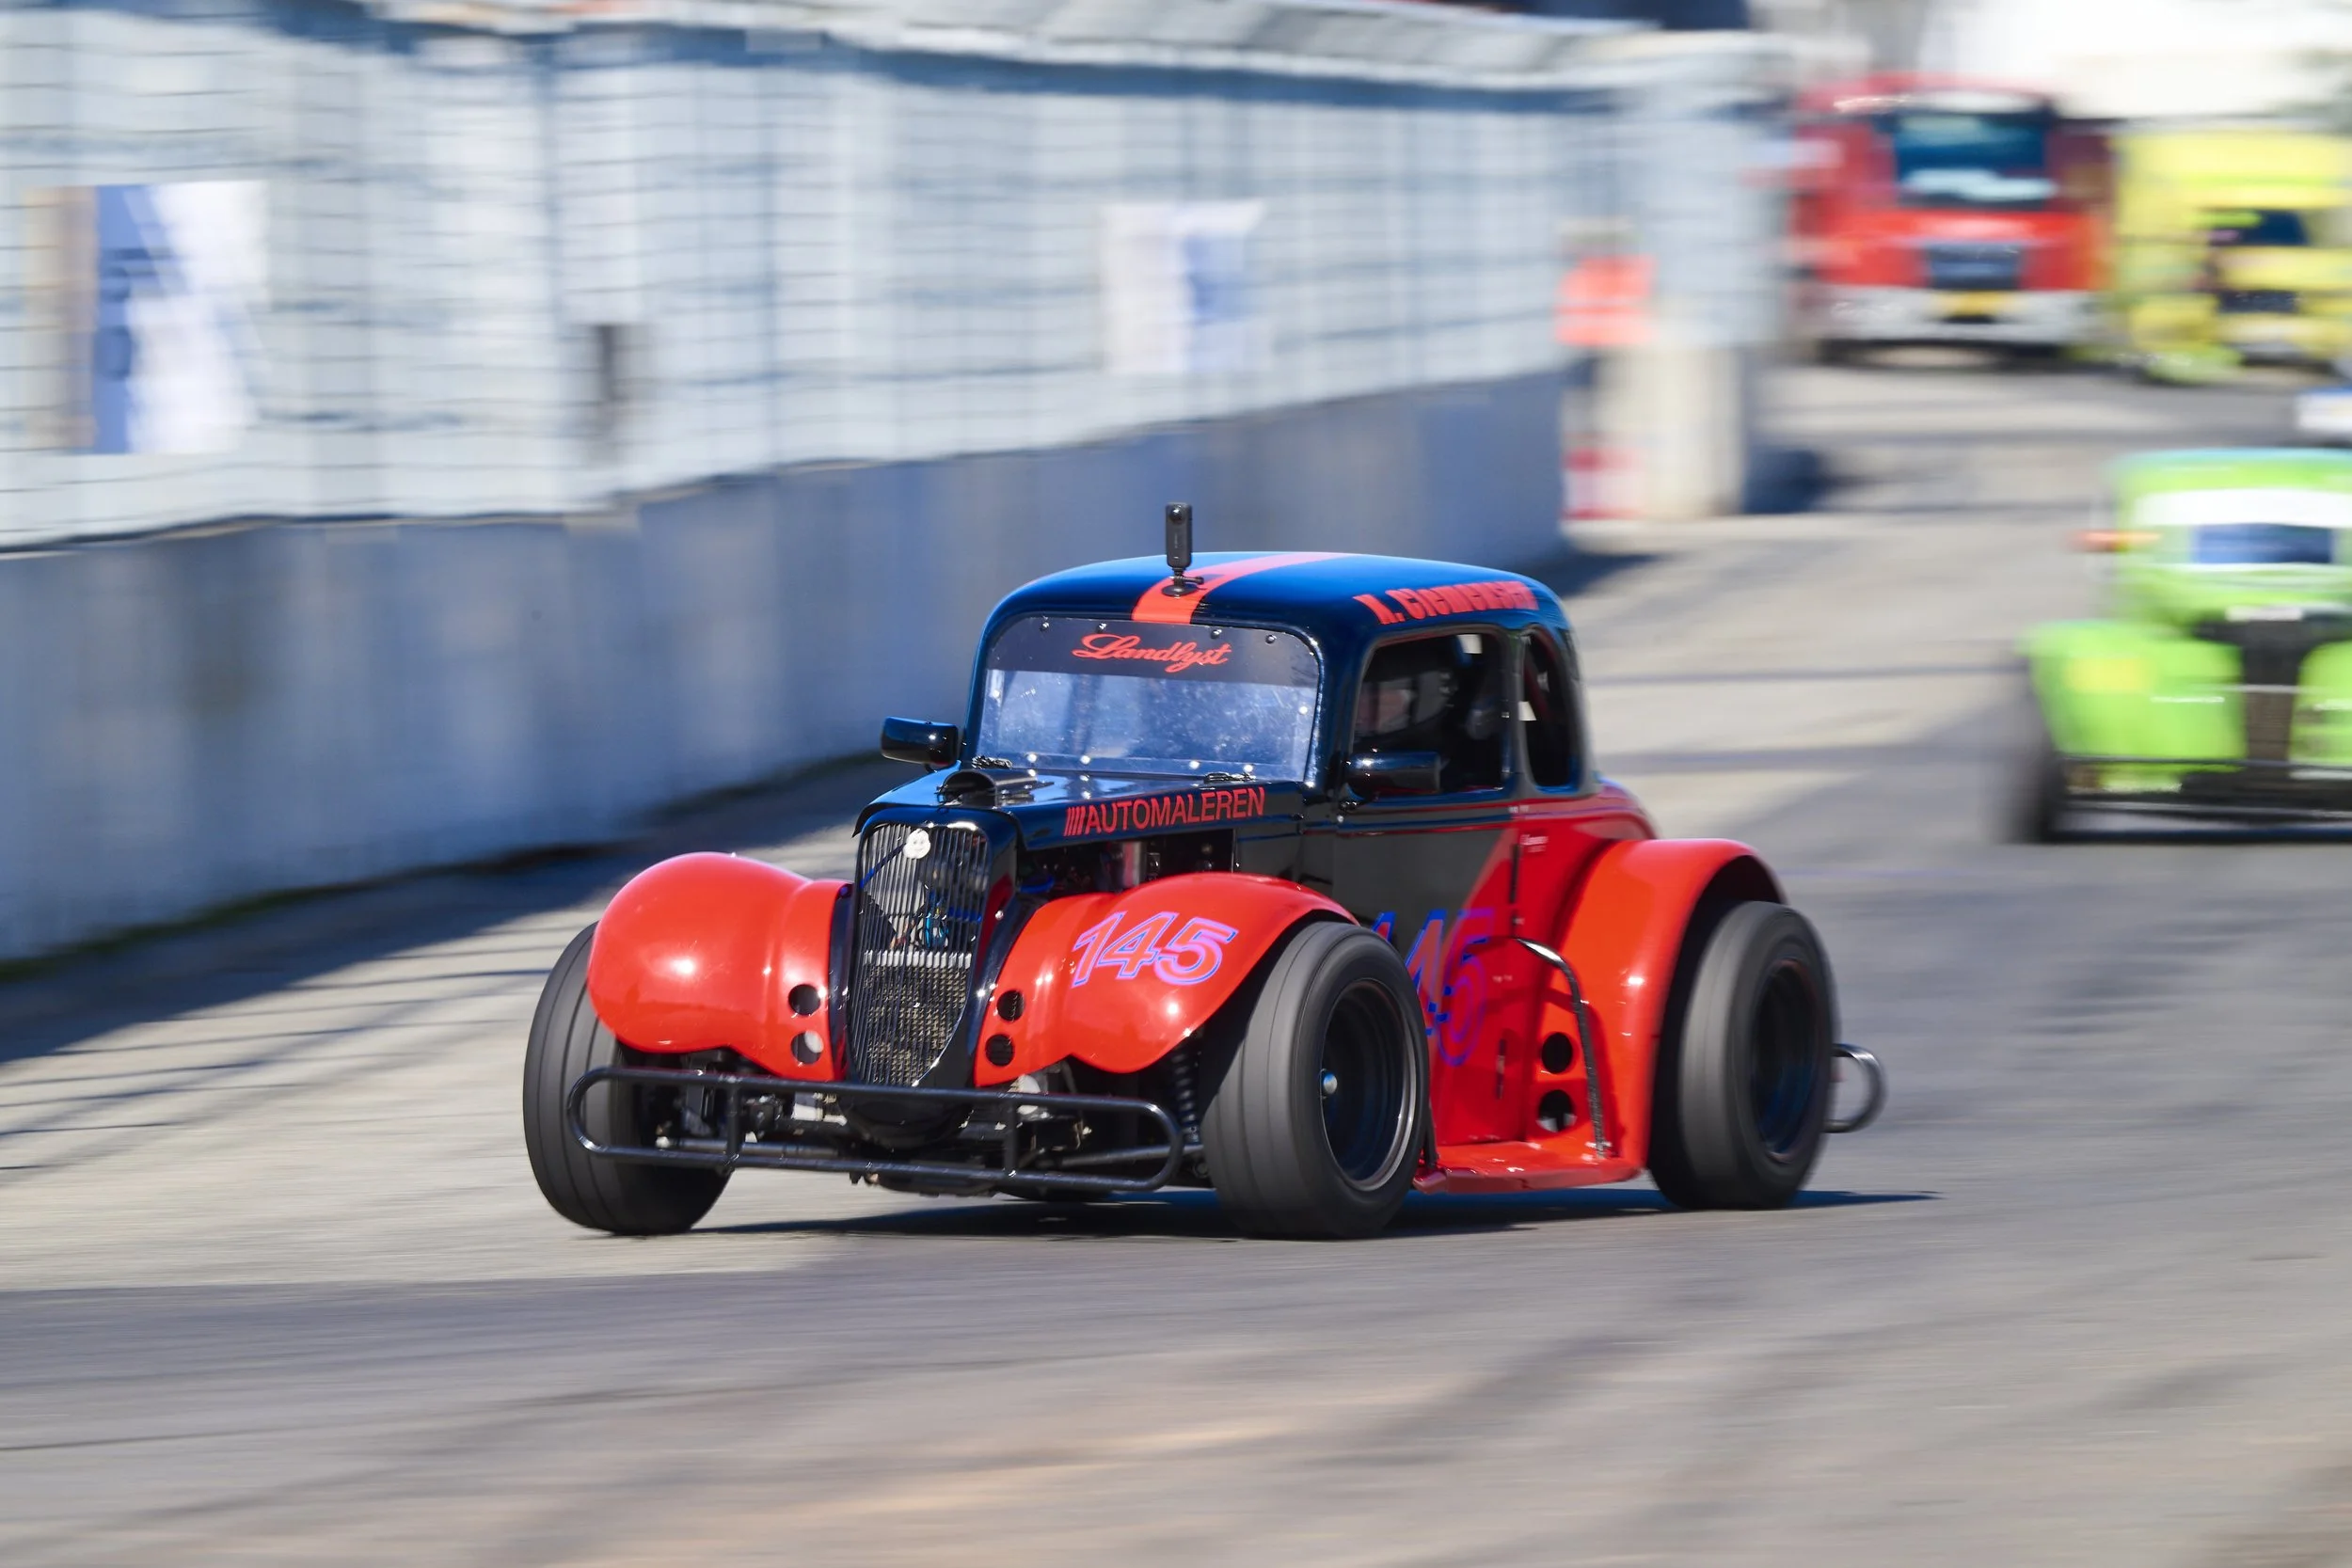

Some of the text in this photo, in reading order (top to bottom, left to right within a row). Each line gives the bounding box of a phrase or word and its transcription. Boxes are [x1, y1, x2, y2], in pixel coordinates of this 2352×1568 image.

[1072, 633, 1232, 673] Landlyst
[1084, 786, 1265, 835] AUTOMALEREN
[1070, 911, 1240, 989] 145
